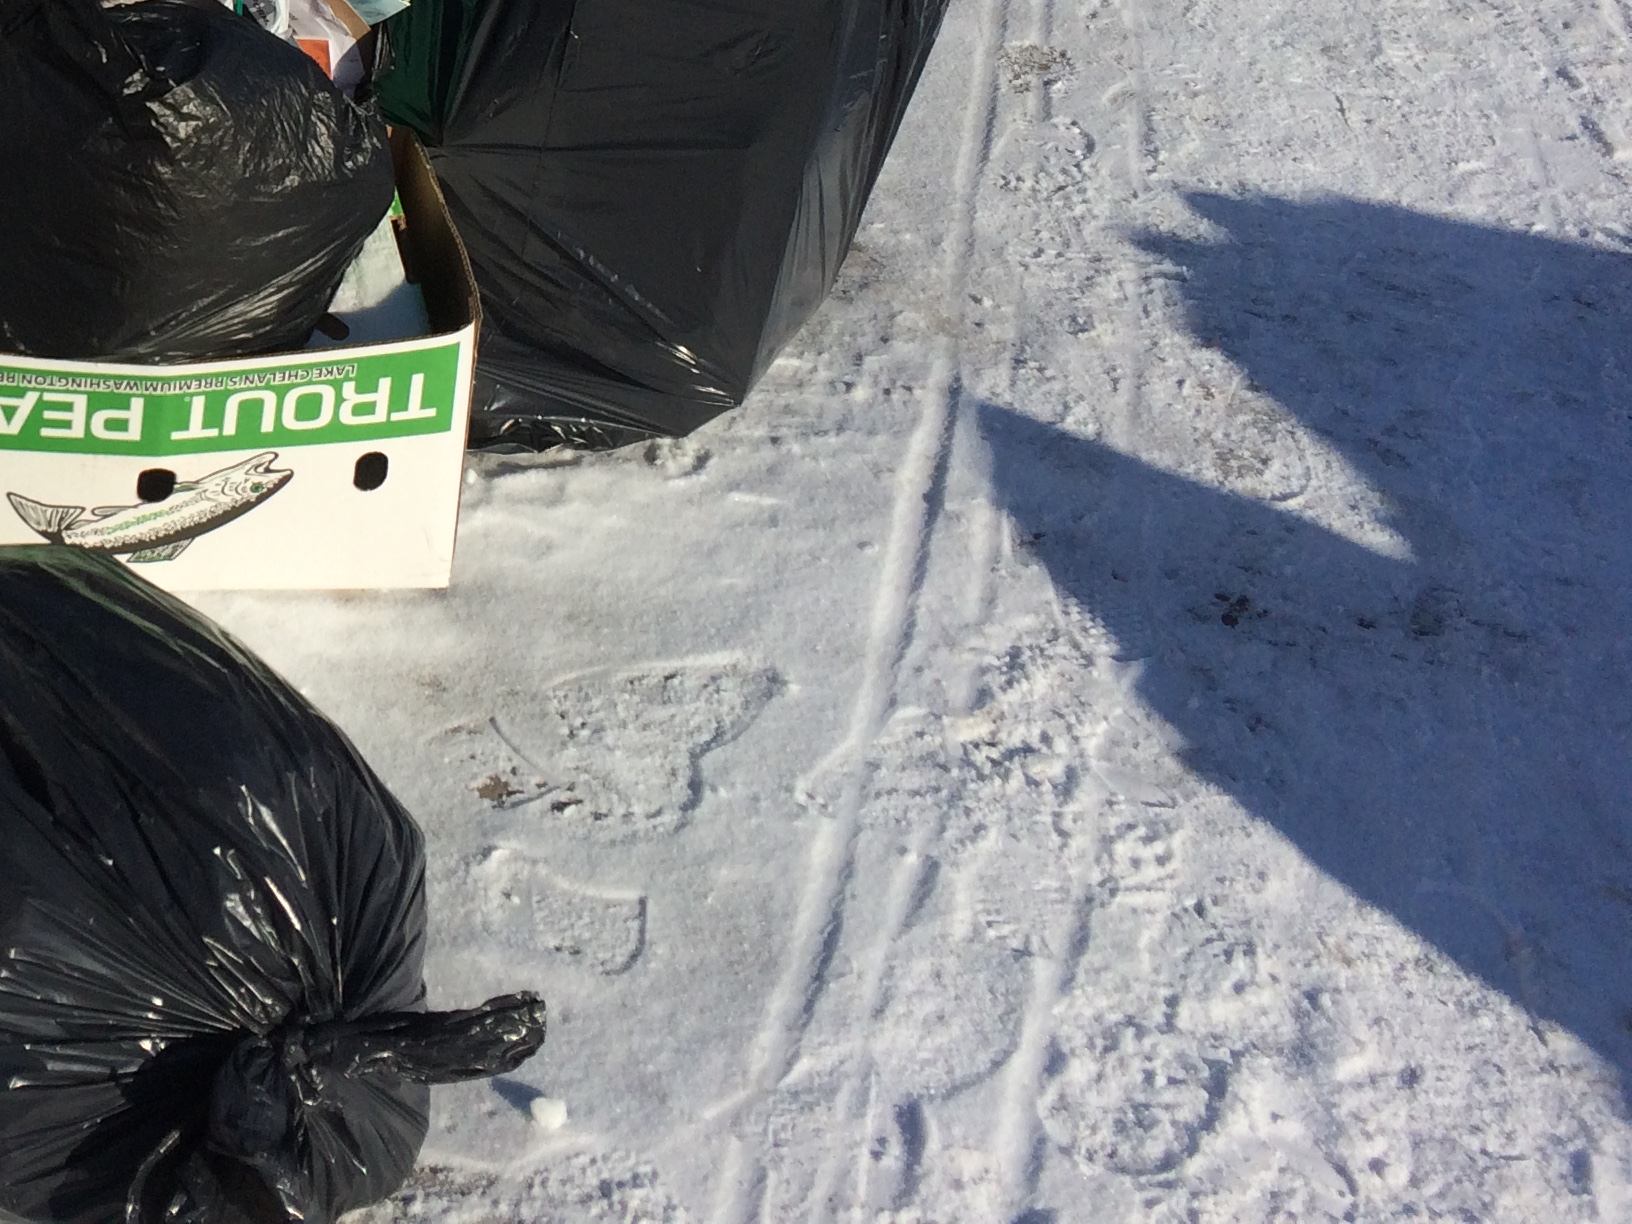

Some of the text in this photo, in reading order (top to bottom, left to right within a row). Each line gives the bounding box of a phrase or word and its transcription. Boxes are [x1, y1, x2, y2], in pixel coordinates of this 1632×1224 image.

[229, 368, 311, 387] CHELAN'S
[314, 363, 357, 380] LAKE
[21, 374, 139, 393] WASHINGTON
[143, 376, 225, 393] PREMIUM
[170, 373, 437, 441] TROUT
